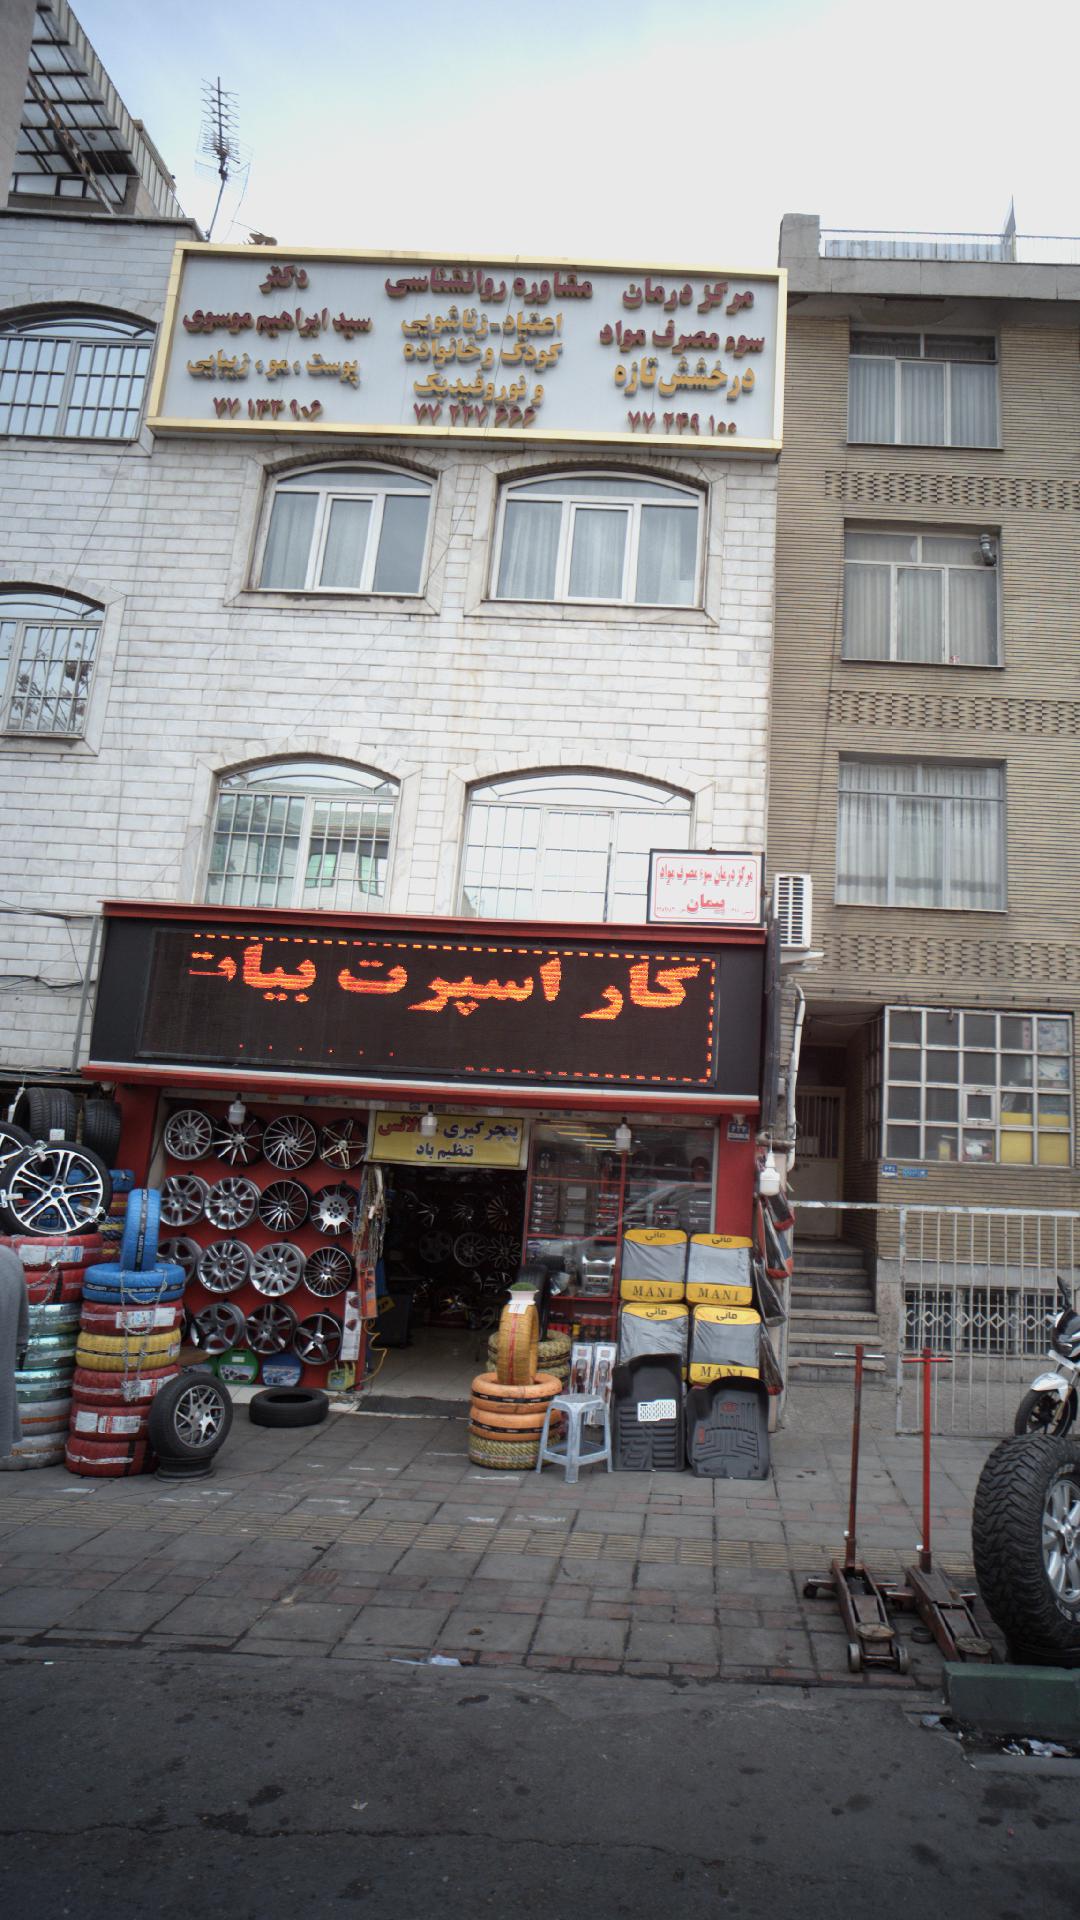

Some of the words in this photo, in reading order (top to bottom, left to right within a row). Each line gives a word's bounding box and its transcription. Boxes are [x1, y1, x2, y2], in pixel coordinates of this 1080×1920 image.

[259, 264, 309, 294] دکتر
[385, 266, 507, 304] روانشناسی
[512, 270, 593, 305] مشاوره
[622, 276, 693, 312] درمان
[697, 281, 754, 315] مرکز
[182, 309, 254, 334] موسوی
[256, 307, 330, 338] ابراهیم
[332, 312, 373, 340] سید
[600, 319, 646, 353] مواد
[652, 319, 720, 355] مصرف
[186, 349, 251, 380] زیبایی
[501, 342, 563, 374] کودک
[614, 356, 659, 397] تازه
[658, 356, 755, 402] درخشش
[580, 962, 700, 1021] کار
[416, 1143, 434, 1158] باد
[437, 1144, 474, 1159] تنظیم
[645, 1231, 666, 1241] مانی
[712, 1236, 733, 1245] مانی
[632, 1285, 673, 1299] MANI
[698, 1288, 740, 1302] MANI
[646, 1308, 668, 1318] مانی
[716, 1312, 738, 1322] مانی
